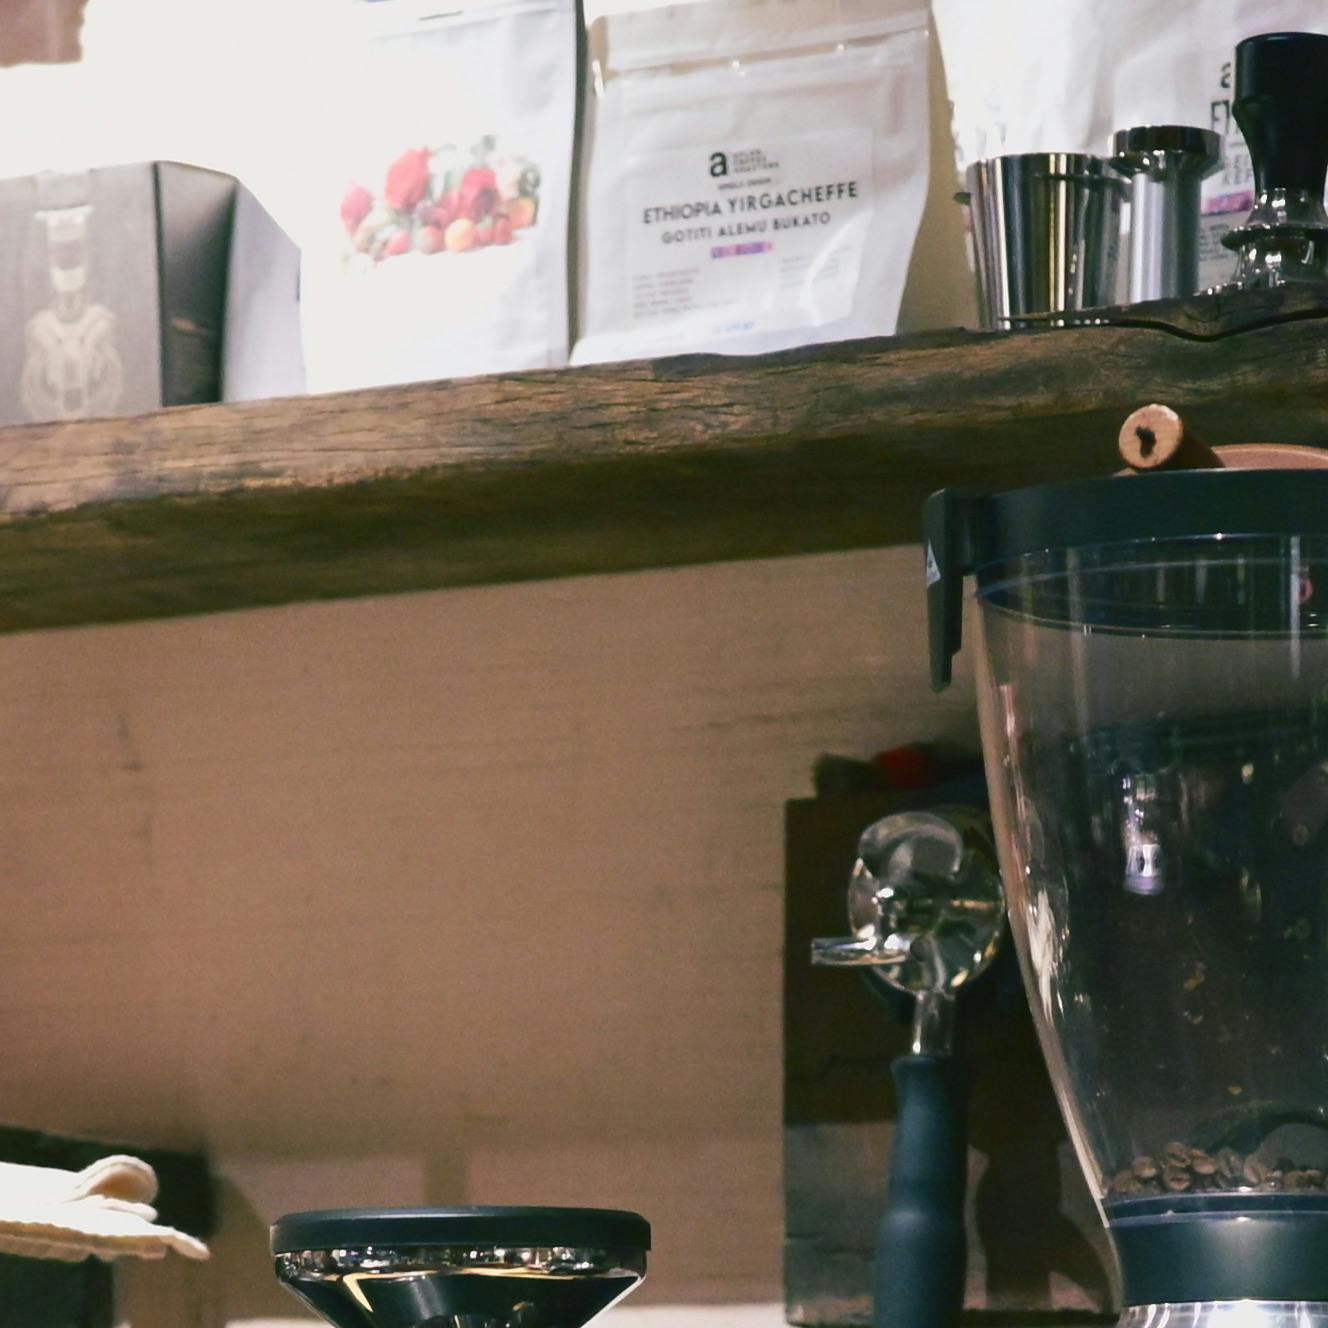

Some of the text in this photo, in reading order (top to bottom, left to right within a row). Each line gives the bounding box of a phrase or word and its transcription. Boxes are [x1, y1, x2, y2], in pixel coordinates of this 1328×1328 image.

[709, 151, 727, 177] a
[643, 201, 722, 224] ETHIOPIA
[729, 181, 859, 213] YIRGACHEFFE
[661, 211, 831, 244] GOTITI ALEMU BUKATO
